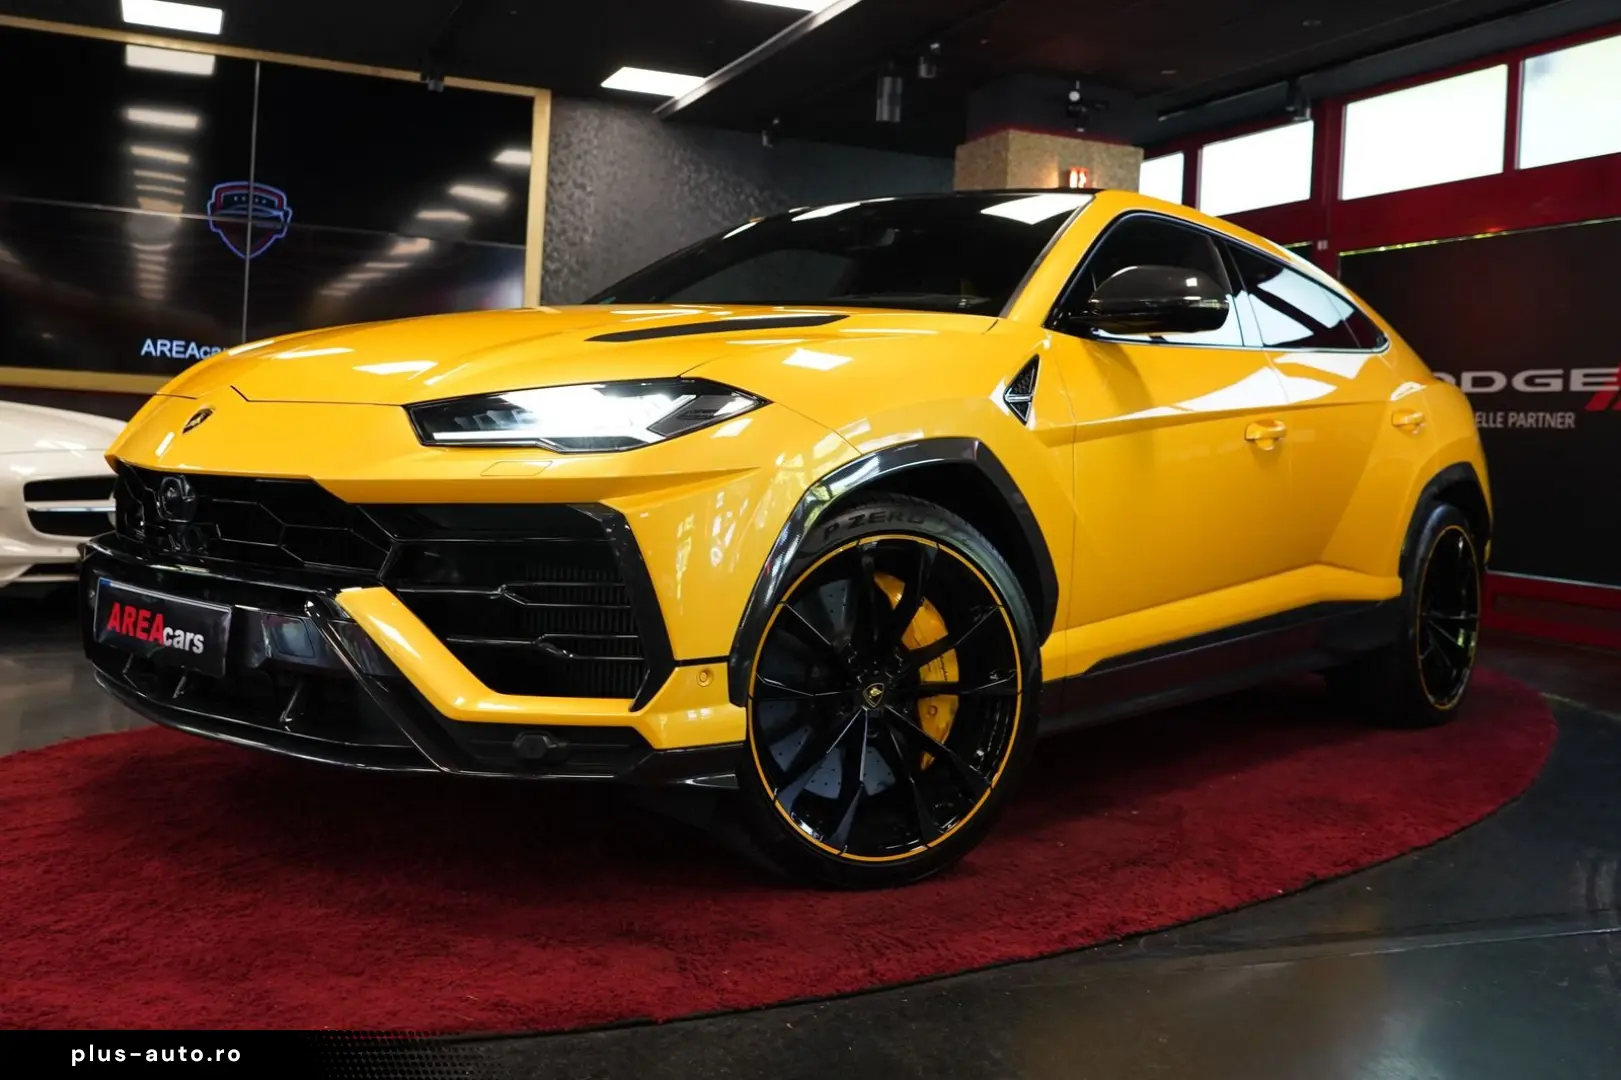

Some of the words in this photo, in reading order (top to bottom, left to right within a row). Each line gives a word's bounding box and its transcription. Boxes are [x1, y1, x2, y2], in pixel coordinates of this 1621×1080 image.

[1508, 411, 1576, 429] PARTNER
[824, 522, 839, 540] P
[106, 601, 205, 654] AREAcars
